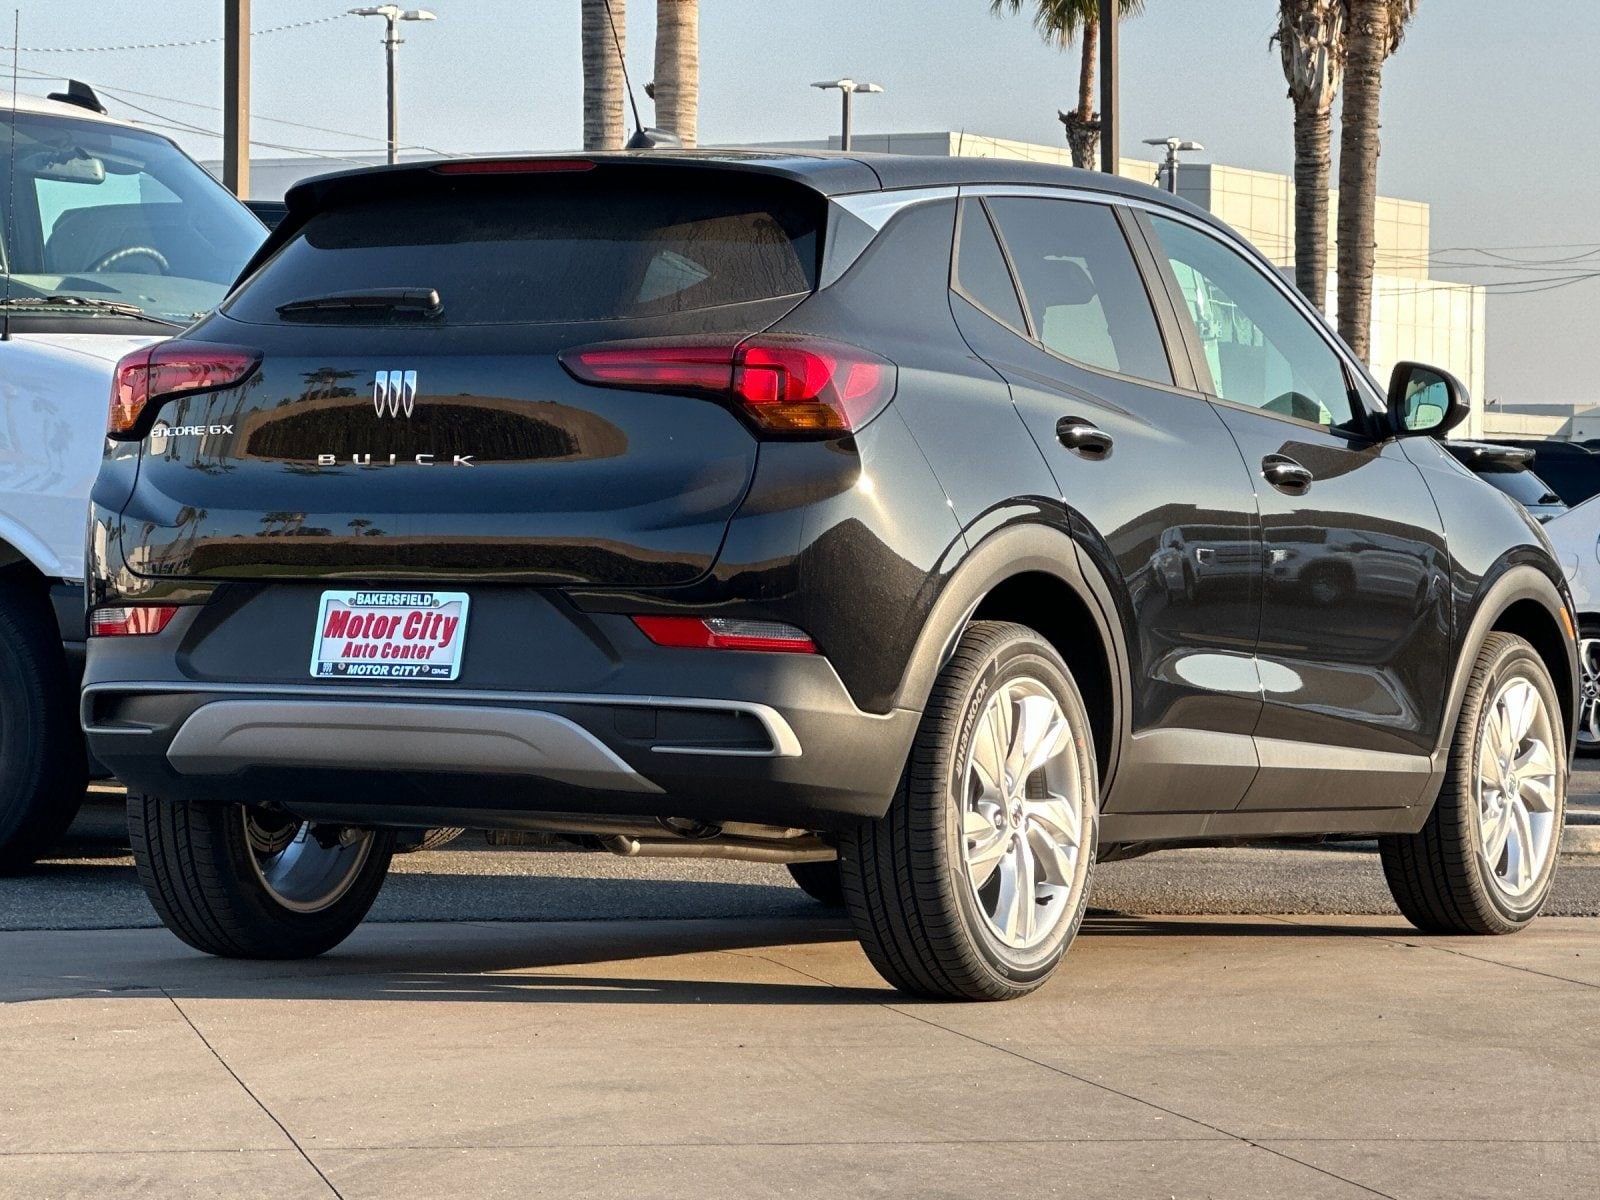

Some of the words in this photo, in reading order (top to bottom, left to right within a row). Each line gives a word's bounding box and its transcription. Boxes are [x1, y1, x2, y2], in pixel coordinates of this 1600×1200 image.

[151, 425, 206, 437] ENCORE
[209, 424, 234, 435] GX
[317, 453, 475, 468] BUICK
[356, 593, 432, 606] BAKERSFIELD
[324, 610, 402, 639] Motor
[403, 611, 459, 648] City
[341, 642, 378, 658] Auto
[380, 642, 435, 659] Center
[346, 664, 389, 675] MOTOR
[391, 666, 420, 676] CITY
